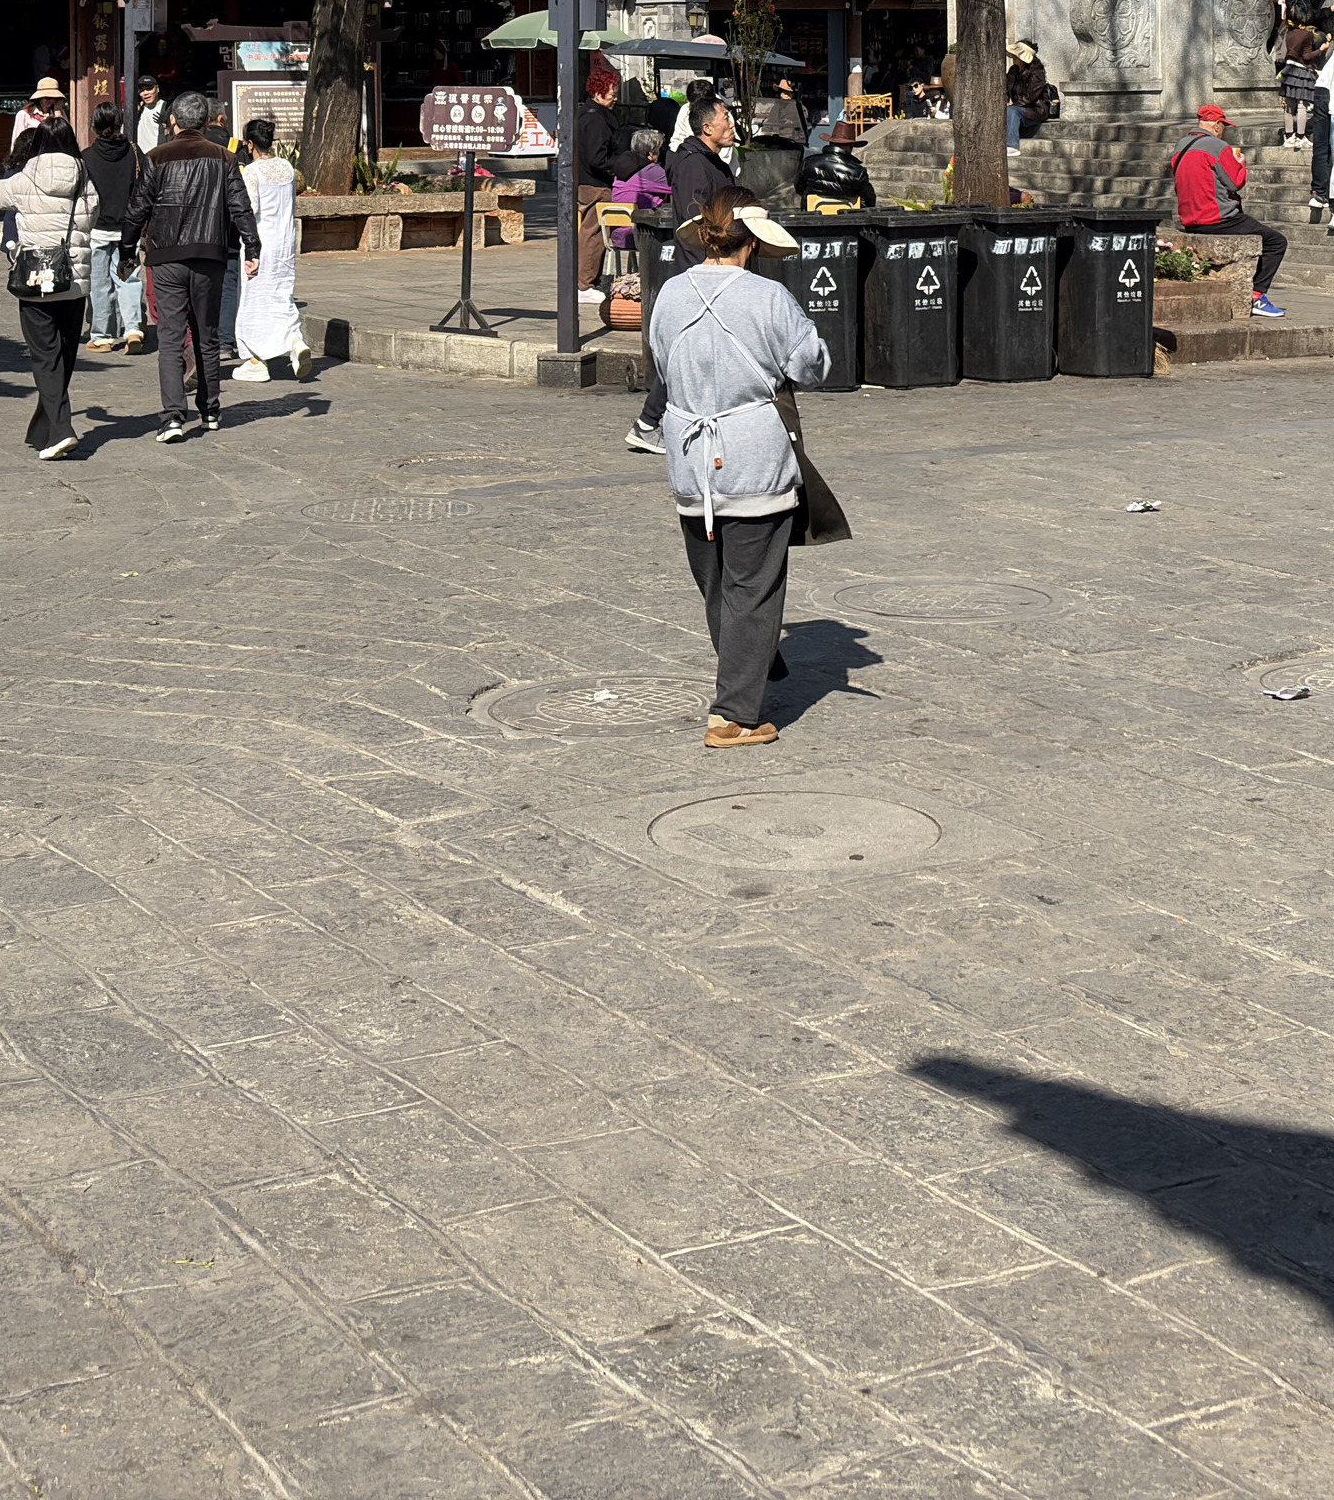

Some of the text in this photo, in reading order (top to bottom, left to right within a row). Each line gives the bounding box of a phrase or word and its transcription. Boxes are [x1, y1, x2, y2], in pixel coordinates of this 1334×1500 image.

[809, 300, 839, 308] 其他垃圾
[915, 298, 943, 306] 其他垃圾
